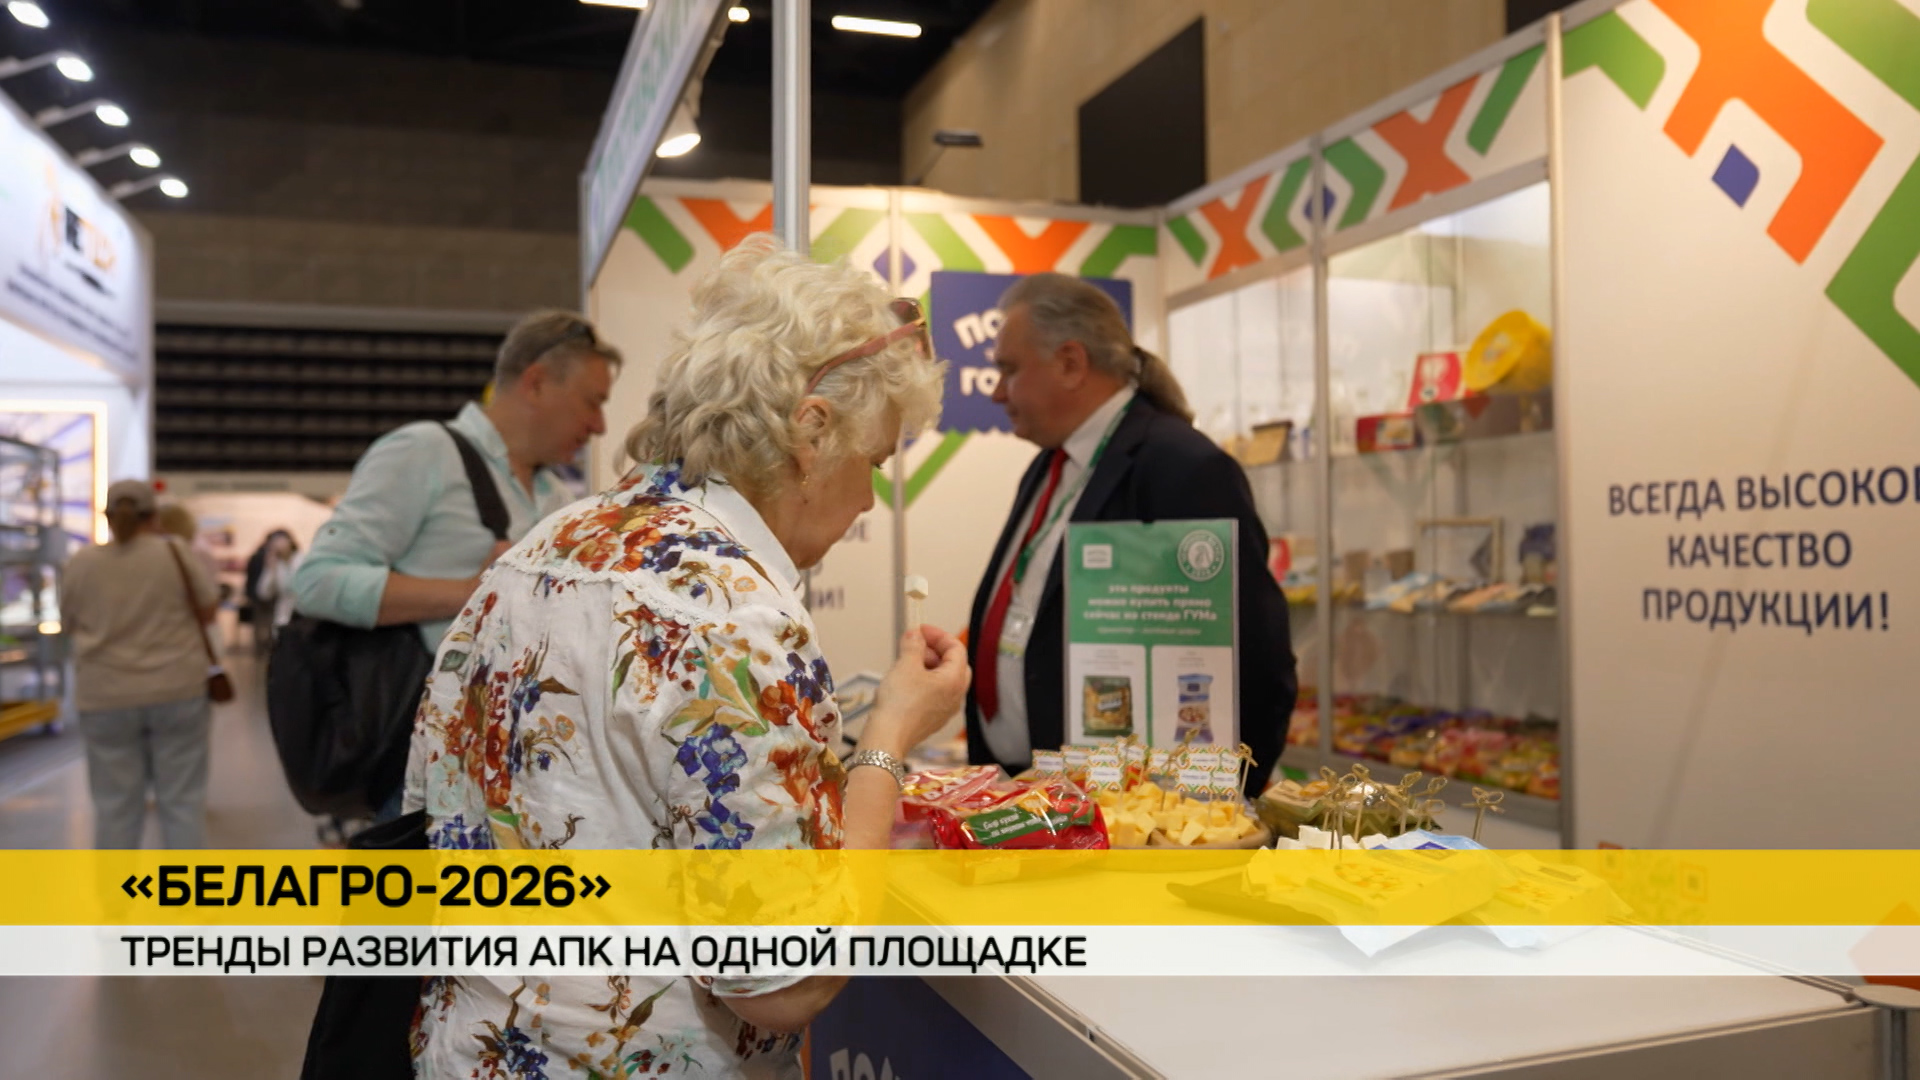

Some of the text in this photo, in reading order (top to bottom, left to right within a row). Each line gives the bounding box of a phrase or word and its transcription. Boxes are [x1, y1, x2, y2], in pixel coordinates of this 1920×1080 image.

[1609, 480, 1725, 521] ВСЕГДА
[1668, 531, 1852, 568] КАЧЕСТВО
[1183, 609, 1217, 621] ГУМа
[1643, 588, 1889, 636] ПРОДУКЦИИ!
